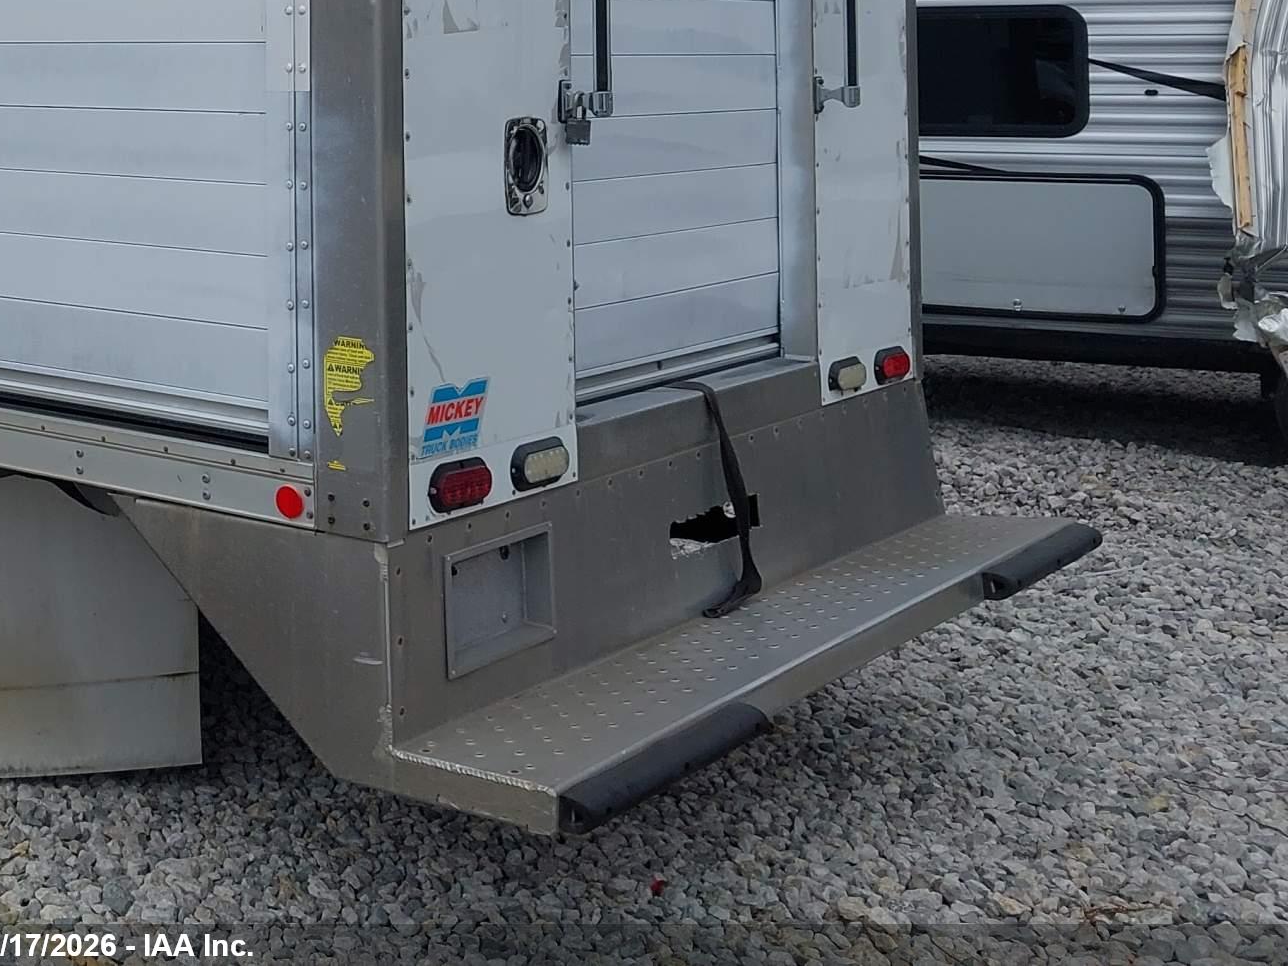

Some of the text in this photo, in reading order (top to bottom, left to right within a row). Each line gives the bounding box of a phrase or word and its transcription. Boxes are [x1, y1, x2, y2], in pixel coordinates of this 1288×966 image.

[334, 339, 365, 349] WARNIN
[427, 396, 484, 425] MICKEY
[422, 441, 447, 455] TRUCK
